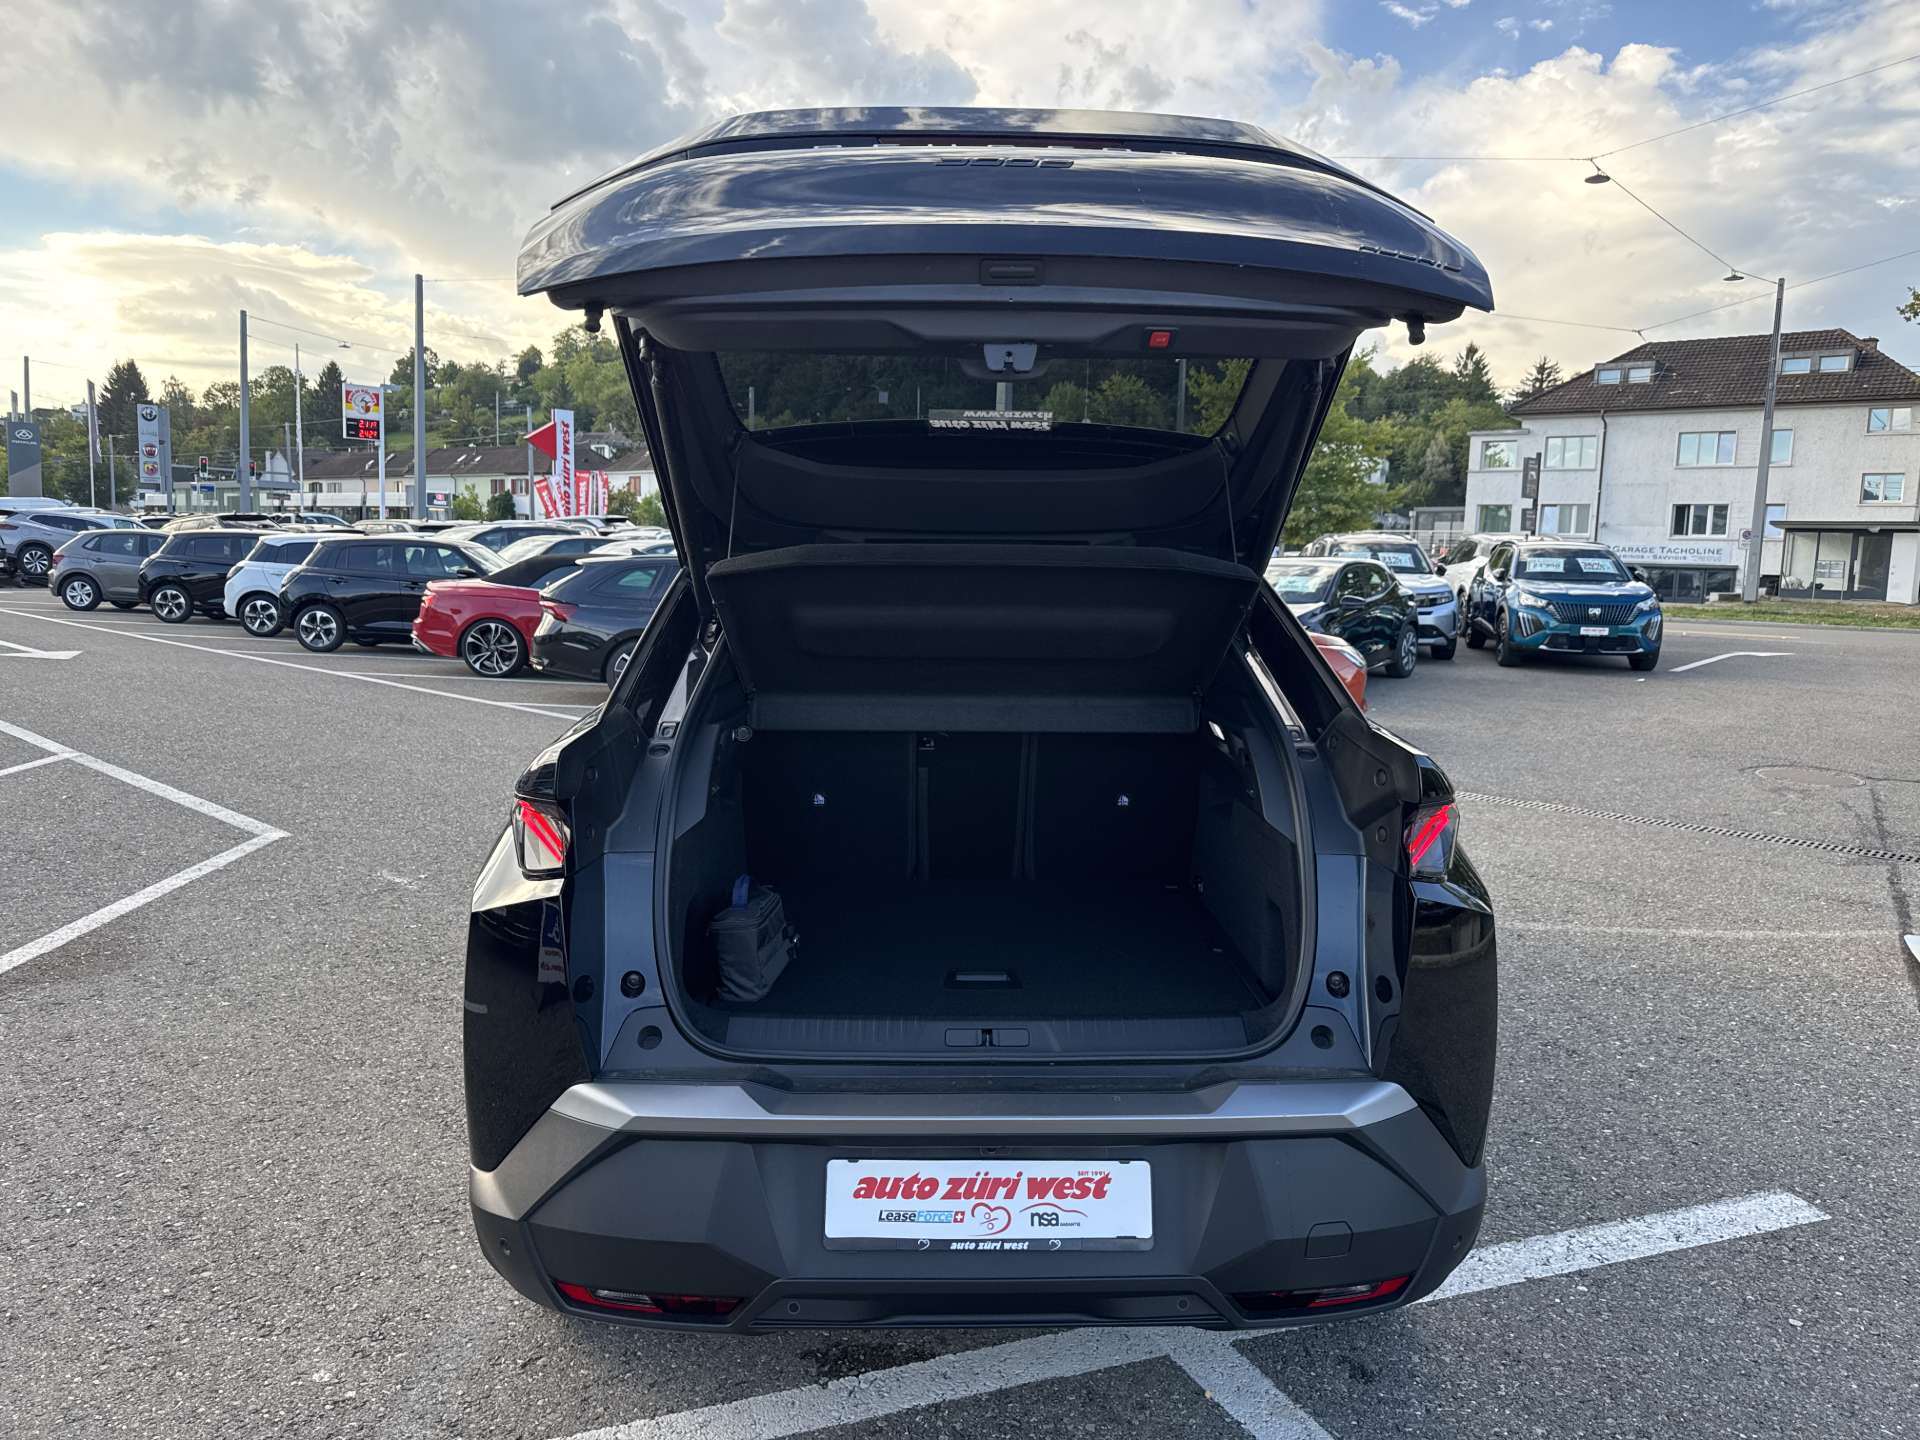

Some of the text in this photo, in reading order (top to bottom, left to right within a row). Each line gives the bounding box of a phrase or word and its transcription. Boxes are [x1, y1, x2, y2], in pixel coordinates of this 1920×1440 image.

[1659, 546, 1723, 556] TACHOLINE
[853, 1171, 1112, 1200] auto züri west
[878, 1210, 954, 1222] LeaseForce
[1030, 1212, 1059, 1227] nsa
[950, 1241, 976, 1250] auto
[1003, 1241, 1029, 1250] west
